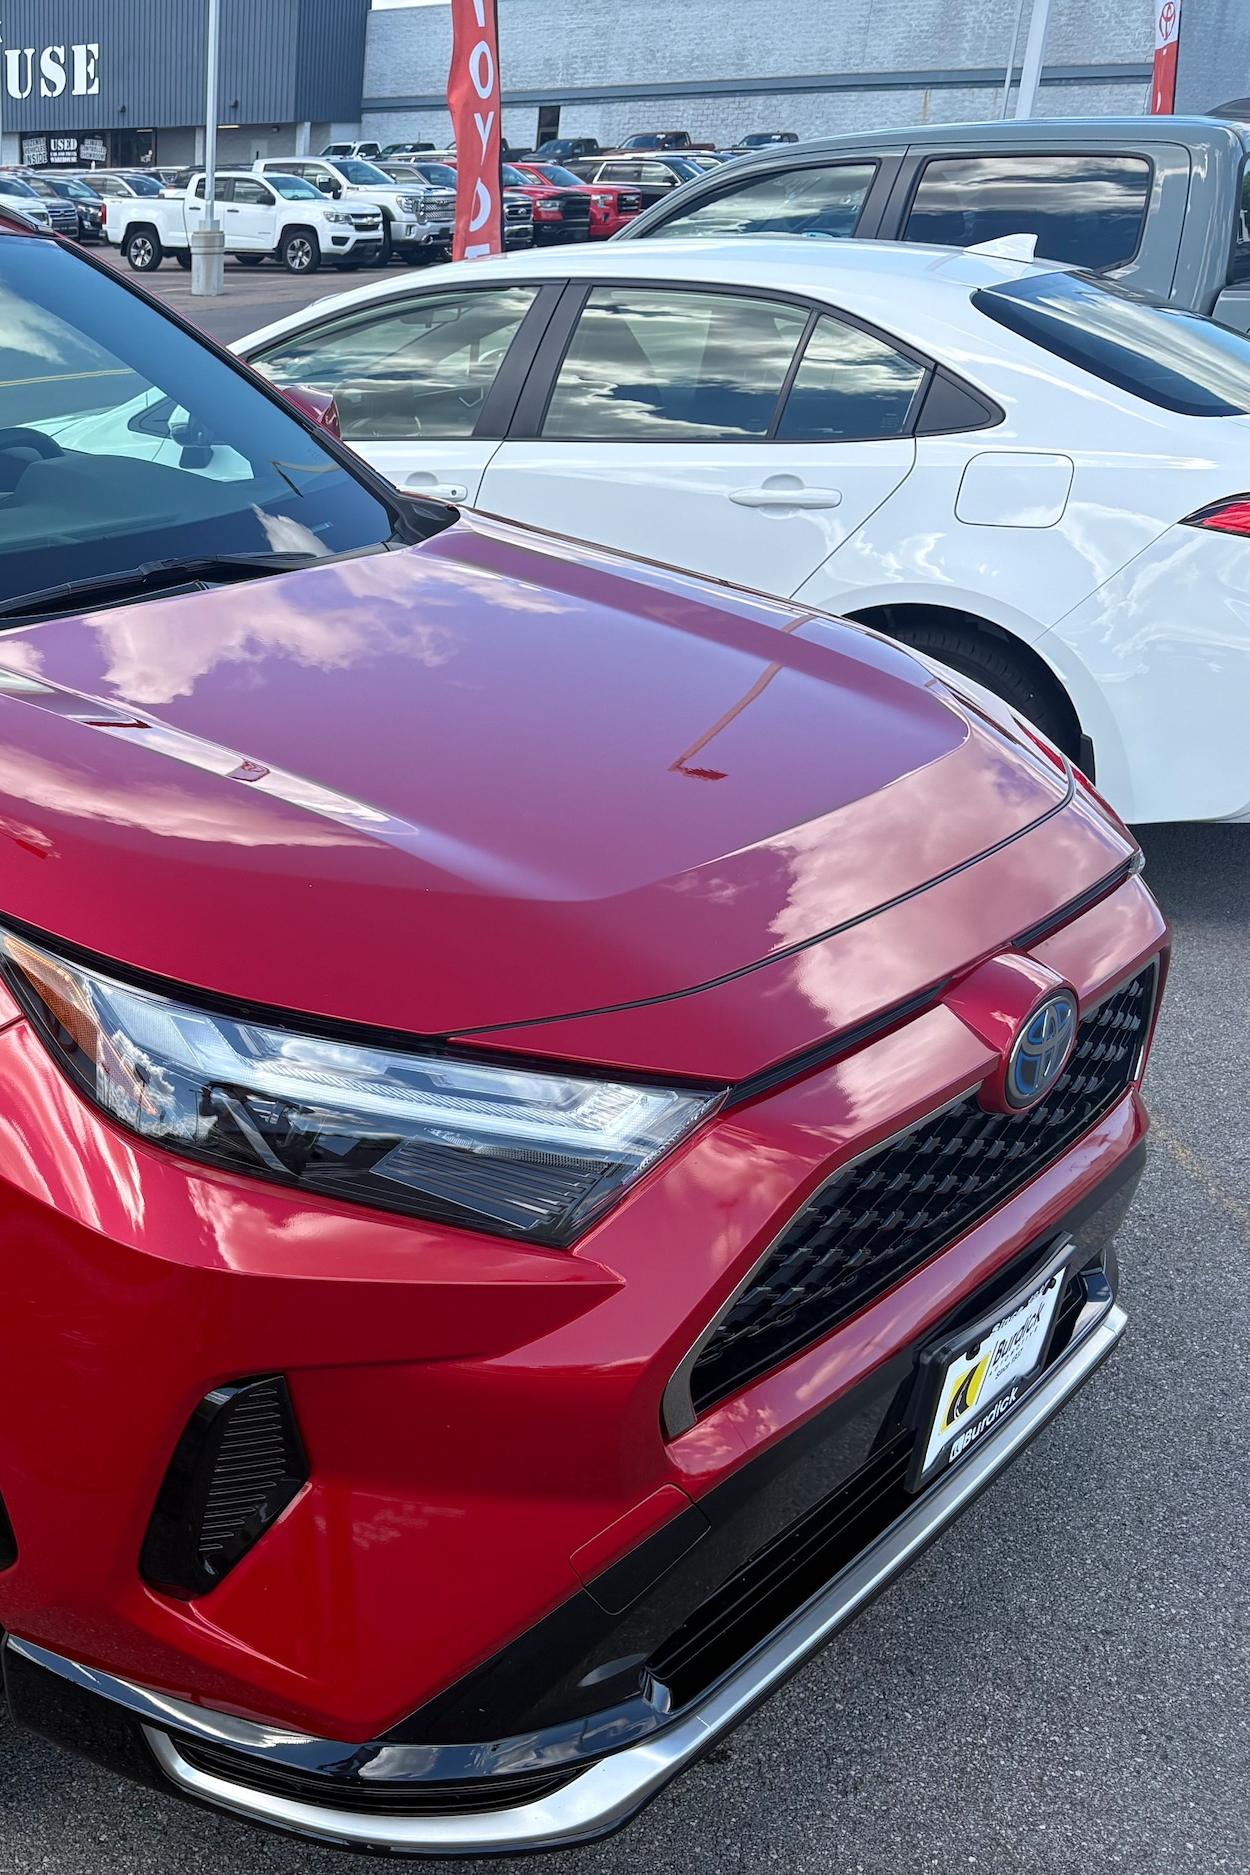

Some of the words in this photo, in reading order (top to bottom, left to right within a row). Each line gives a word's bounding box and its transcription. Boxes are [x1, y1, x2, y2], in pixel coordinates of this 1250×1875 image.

[50, 138, 78, 151] USED
[992, 1302, 1046, 1367] Burdick
[963, 1386, 1019, 1449] Burdick
